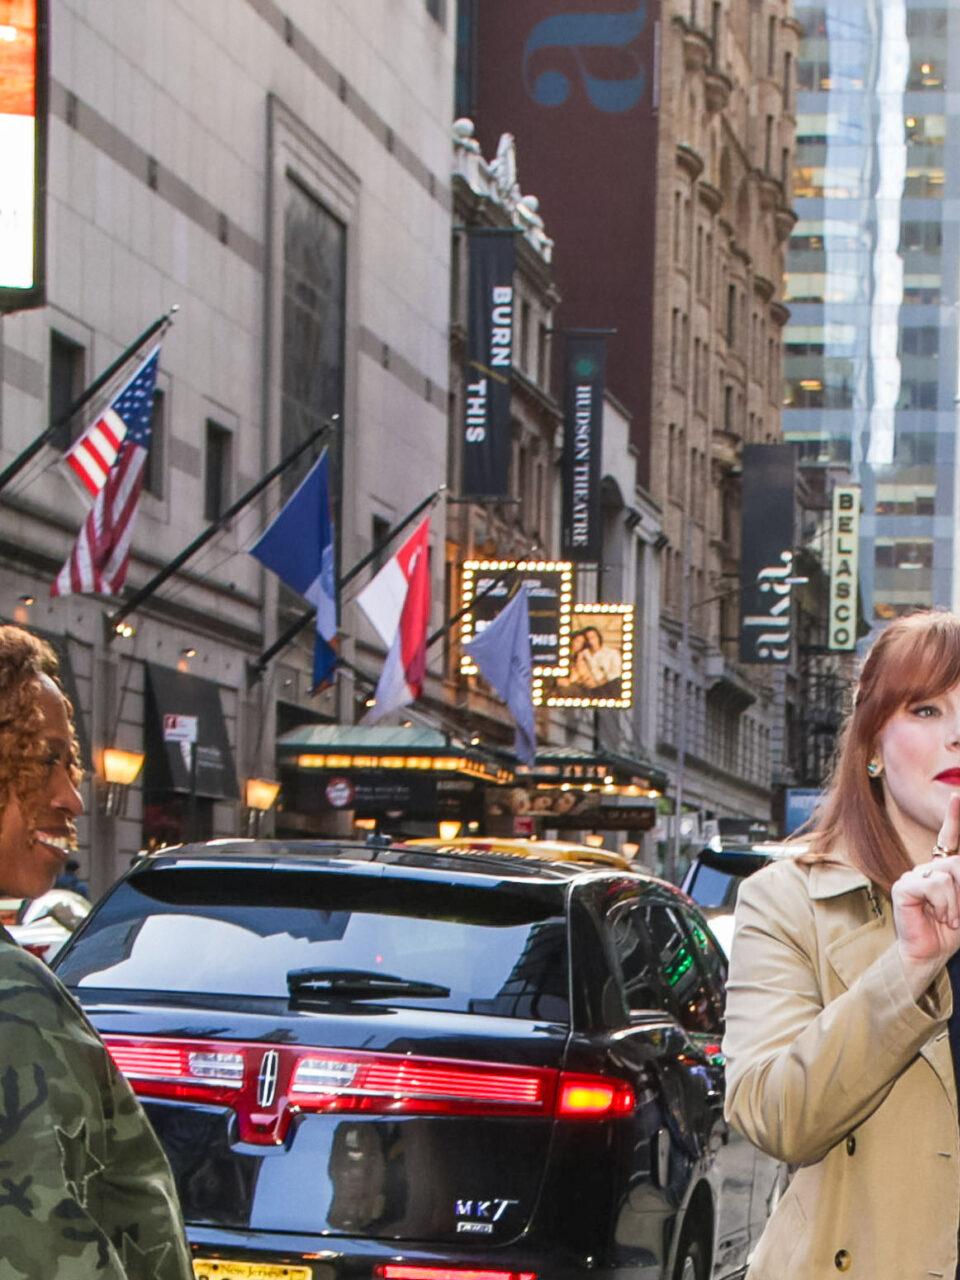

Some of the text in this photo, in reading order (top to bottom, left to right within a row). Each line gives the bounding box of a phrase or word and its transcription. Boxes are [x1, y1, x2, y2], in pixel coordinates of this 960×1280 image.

[491, 286, 513, 366] BURN
[466, 379, 487, 443] THIS
[572, 385, 592, 547] HUDSON THEATRE
[833, 493, 854, 646] BELASCO
[456, 1199, 519, 1222] MKT
